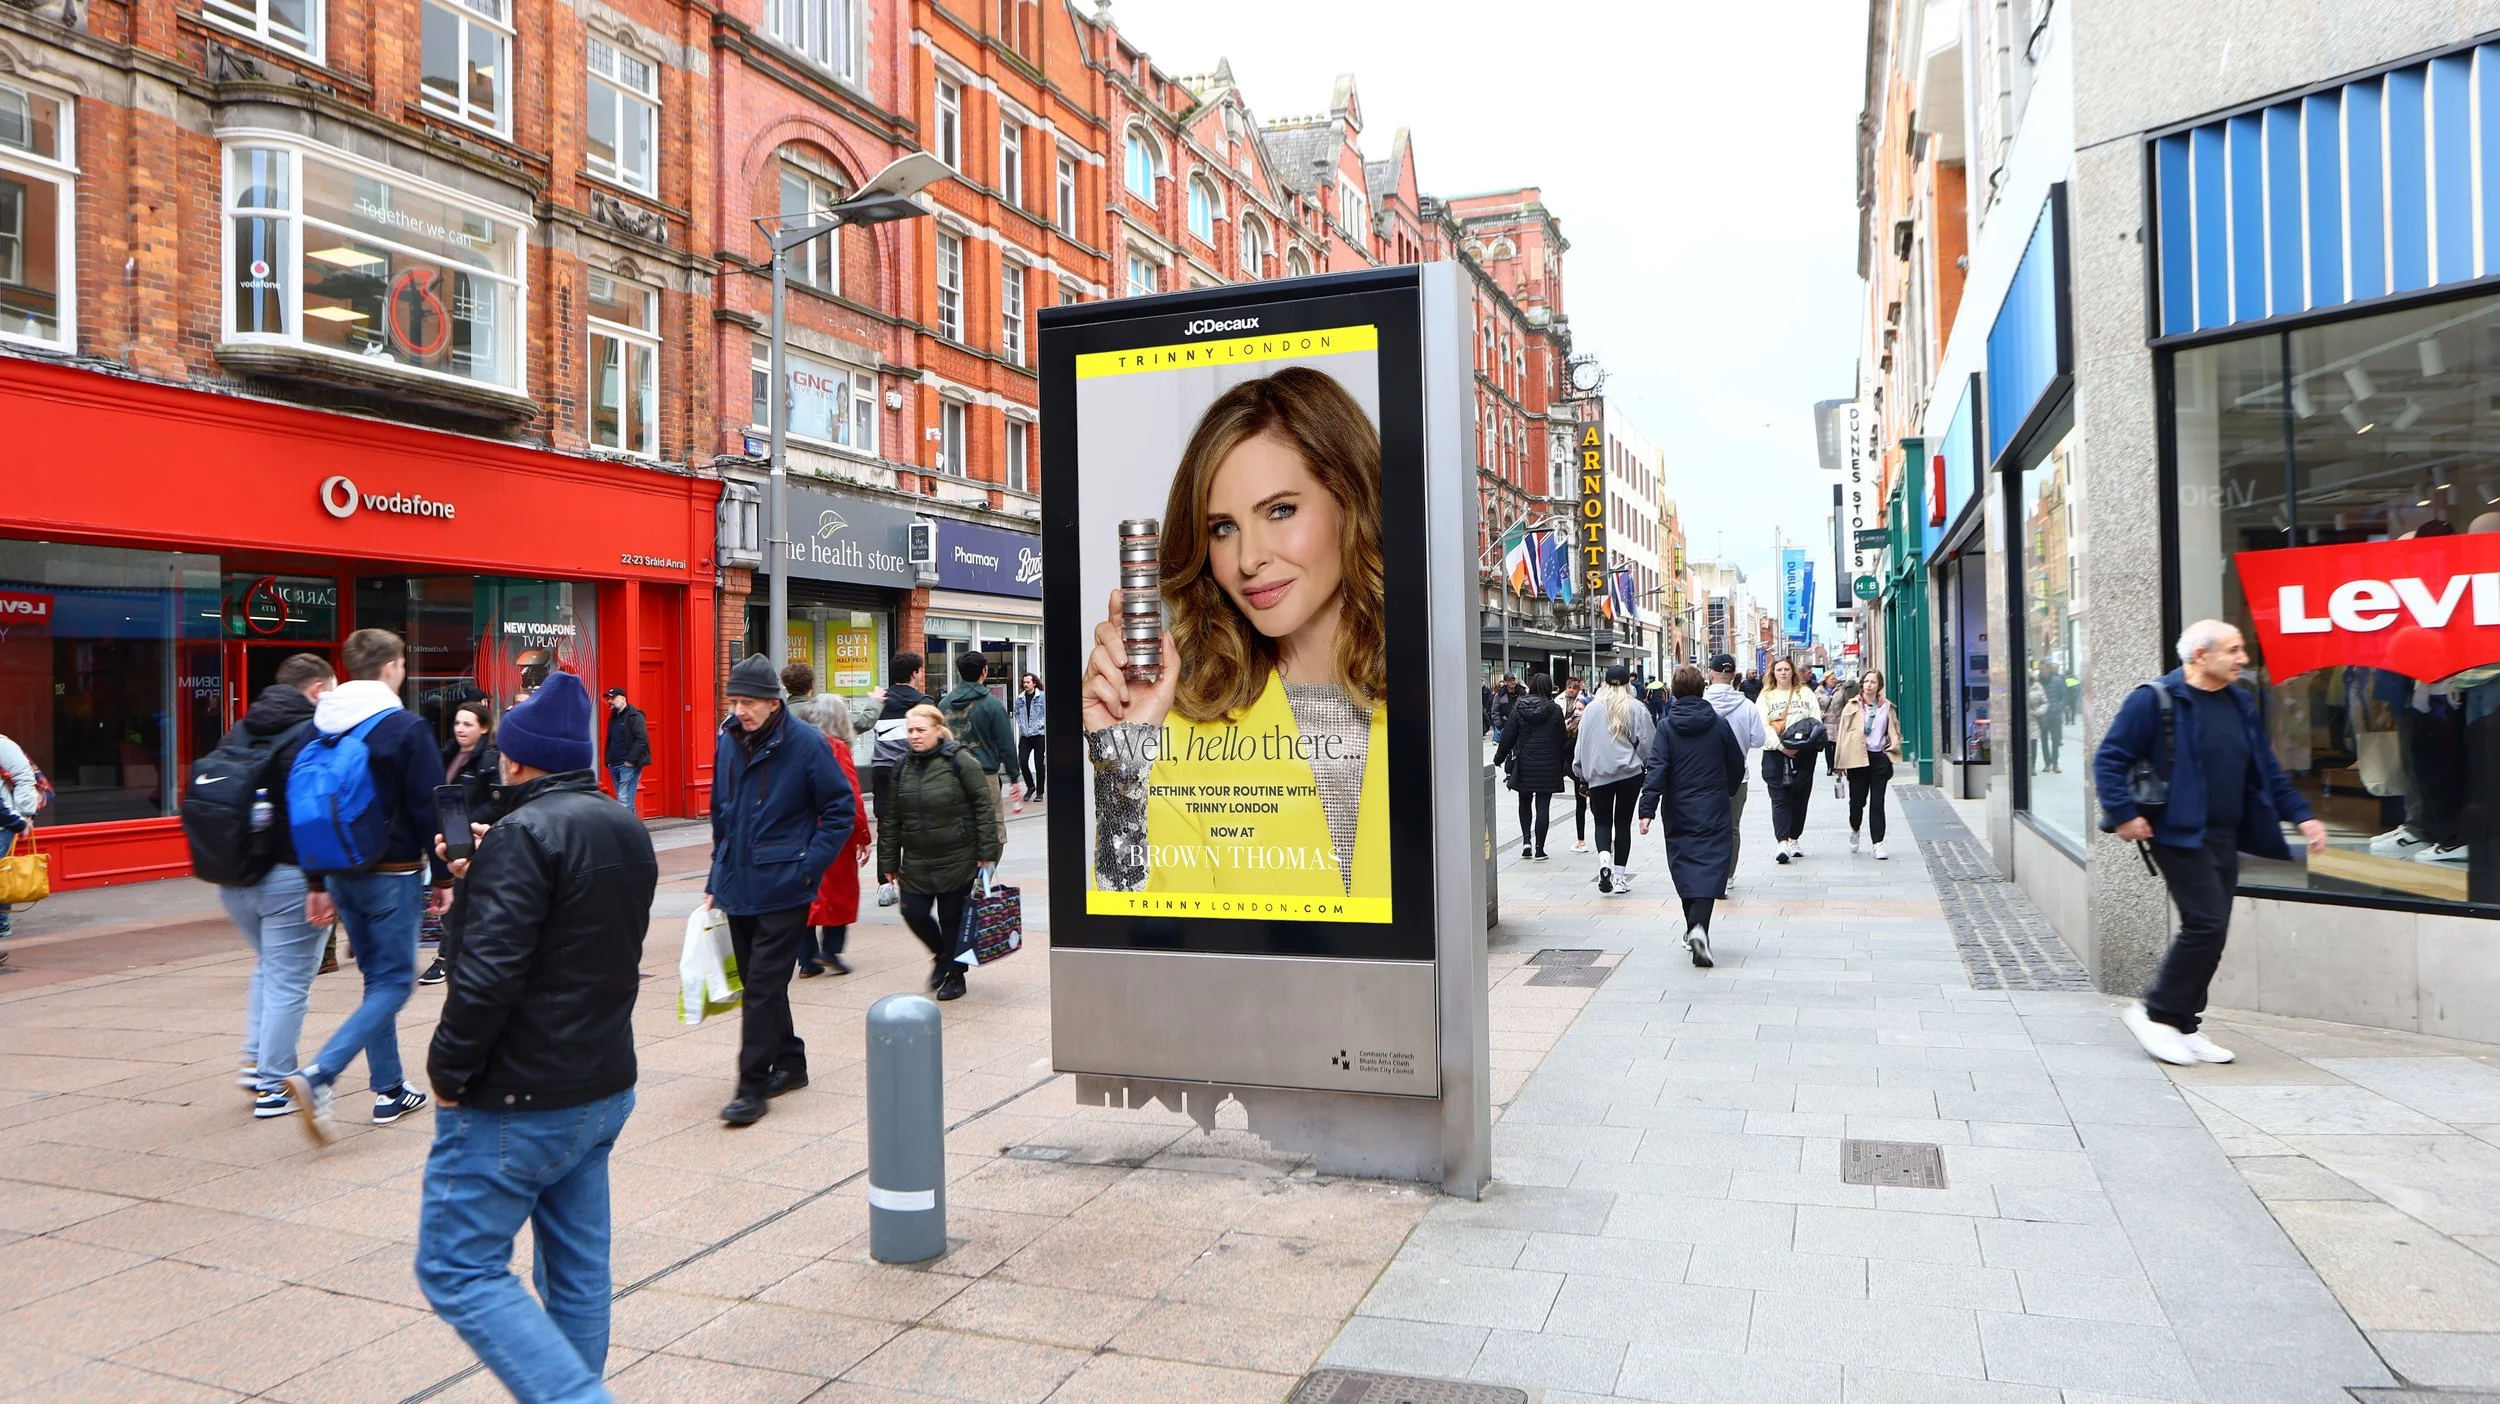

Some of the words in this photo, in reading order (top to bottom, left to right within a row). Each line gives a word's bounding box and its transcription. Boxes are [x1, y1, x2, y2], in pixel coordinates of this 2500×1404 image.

[359, 197, 424, 232] Together
[426, 222, 446, 240] we
[448, 228, 472, 248] can
[240, 279, 281, 290] vodafone
[1184, 316, 1259, 336] JCDecaux
[1118, 348, 1215, 368] TRINNY
[1228, 336, 1331, 357] LONDON
[793, 370, 834, 393] GNC
[1850, 408, 1861, 483] DUNNES
[363, 491, 456, 519] vodafone
[1581, 426, 1604, 590] ARNOTTS
[785, 531, 806, 561] he
[811, 535, 863, 568] health
[868, 553, 904, 573] store
[954, 546, 999, 572] Pharmacy
[621, 554, 644, 566] 22-23
[645, 554, 665, 567] Sráid
[1787, 561, 1796, 598] DUBLIN
[503, 621, 526, 634] NEW
[527, 622, 576, 636] VODAFONE
[522, 636, 536, 648] TV
[536, 636, 558, 649] PLAY
[836, 634, 861, 645] BUY
[787, 647, 802, 659] GET
[836, 645, 861, 657] GET
[1109, 726, 1178, 767] Well,
[1186, 726, 1257, 761] hello
[1262, 724, 1361, 761] there...
[1149, 785, 1196, 797] RETHINK
[1197, 785, 1231, 797] YOUR
[1233, 785, 1284, 797] ROUTINE
[1285, 785, 1317, 797] WITH
[1185, 802, 1228, 814] TRINNY
[1229, 802, 1279, 814] LONDON
[1210, 826, 1238, 838] NOW
[1239, 827, 1255, 838] AT
[1129, 844, 1220, 868] BROWN
[1227, 846, 1343, 871] THOMAS
[1128, 899, 1201, 910] TRINNY
[1359, 1050, 1388, 1058] Comhairle
[1389, 1052, 1415, 1060] Cathrach
[1359, 1065, 1379, 1073] Dublin
[1379, 1066, 1392, 1075] City
[1392, 1067, 1415, 1075] Council
